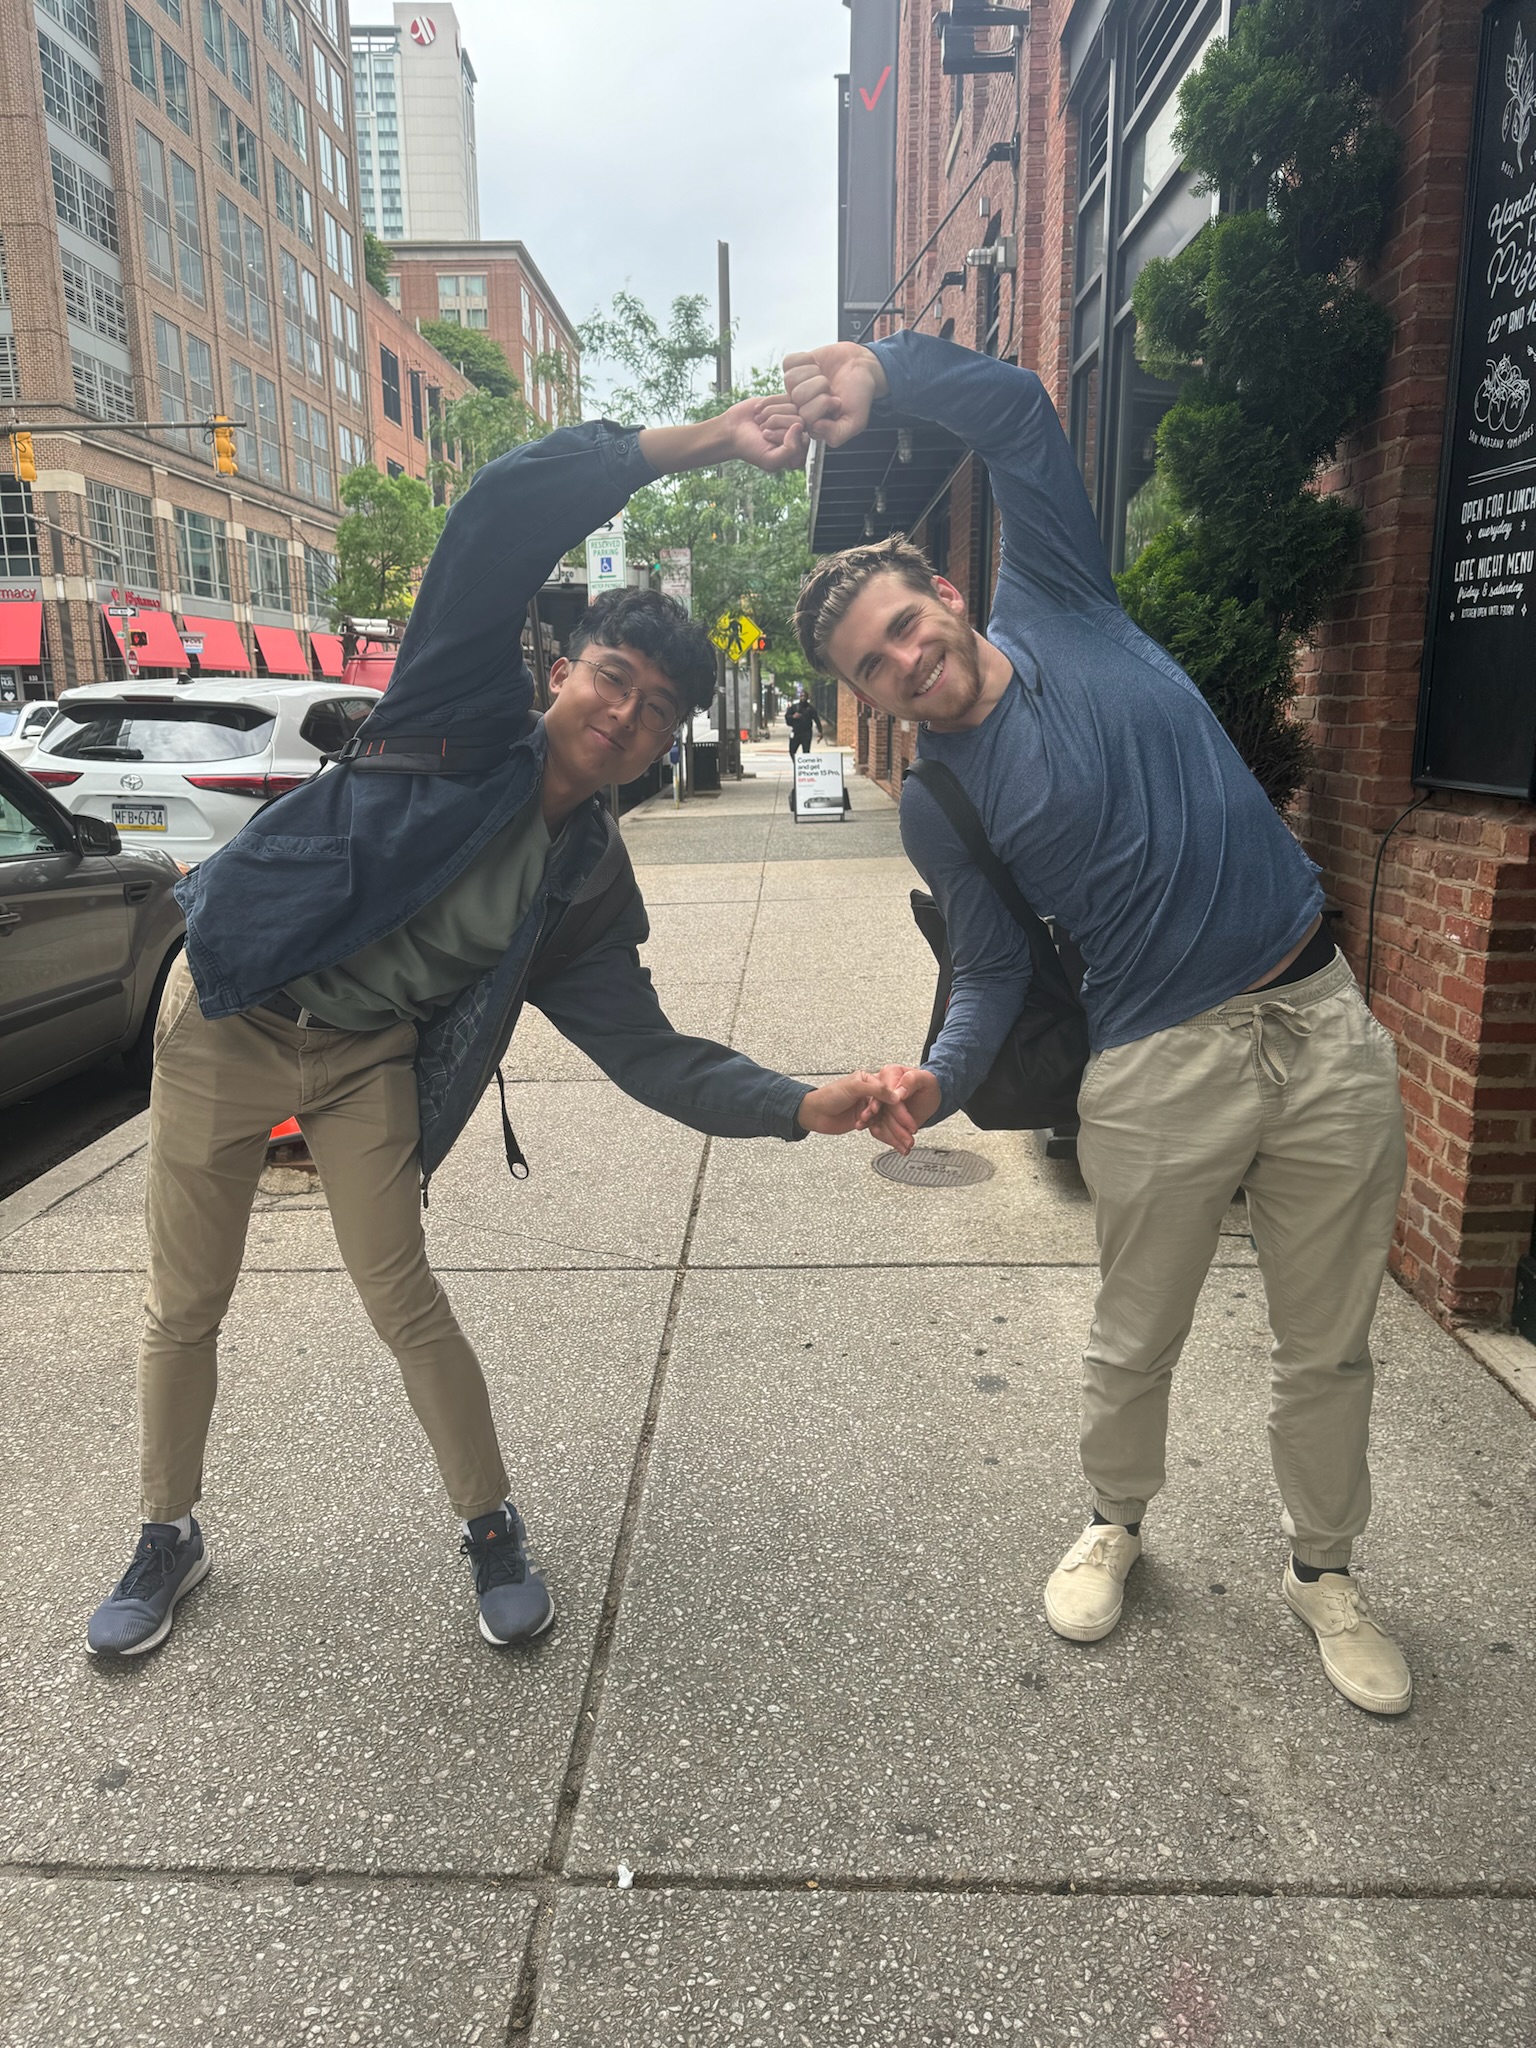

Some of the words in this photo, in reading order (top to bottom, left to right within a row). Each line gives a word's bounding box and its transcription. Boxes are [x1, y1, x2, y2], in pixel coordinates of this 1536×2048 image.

[1508, 306, 1525, 334] AND
[1468, 429, 1479, 445] SAN
[1478, 434, 1504, 449] MARZANO
[1507, 423, 1535, 449] TOMATOES
[1461, 498, 1484, 525] OPEN
[1485, 493, 1505, 520] FOR
[1506, 486, 1536, 515] LUNCH
[1478, 519, 1513, 542] everyday
[590, 540, 620, 549] RESERVED
[593, 548, 619, 557] PARKING
[1454, 558, 1476, 582] LATE
[1477, 553, 1504, 579] NIGHT
[1506, 550, 1535, 576] MENU
